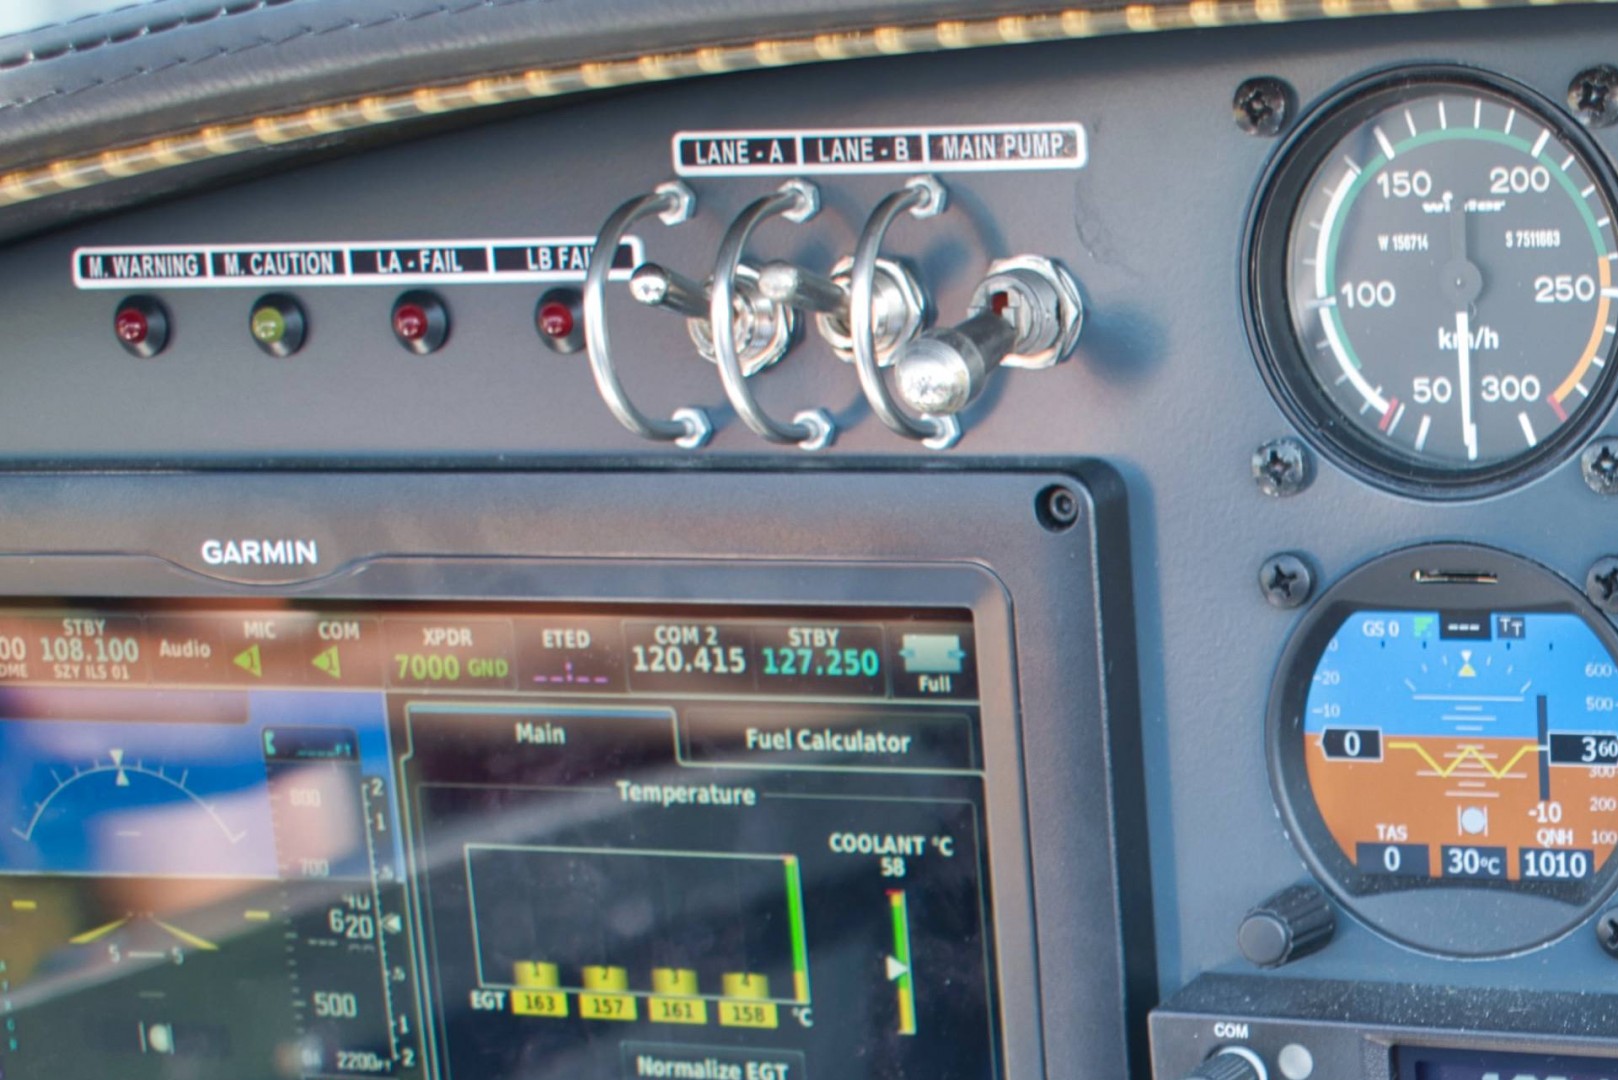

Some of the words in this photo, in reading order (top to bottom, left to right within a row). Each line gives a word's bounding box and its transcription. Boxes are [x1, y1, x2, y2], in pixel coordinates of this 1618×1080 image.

[695, 140, 749, 164] LANE
[769, 140, 784, 163] A
[818, 139, 873, 162] LANE
[895, 138, 909, 161] B
[942, 135, 996, 159] MAIN
[1004, 133, 1063, 158] PUMP
[1377, 170, 1431, 198] 150
[1490, 166, 1550, 192] 200
[89, 256, 108, 277] M.
[113, 255, 198, 277] WARNING
[225, 254, 245, 276] M.
[251, 252, 334, 275] CAUTION
[376, 251, 401, 272] LA
[420, 250, 462, 272] FAIL
[527, 248, 550, 270] LB
[560, 247, 594, 270] FAI
[1341, 281, 1395, 308] 100
[1534, 275, 1595, 302] 250
[1413, 377, 1452, 403] 50
[1481, 376, 1540, 401] 300
[201, 539, 317, 564] GARMIN
[63, 619, 106, 636] STBY
[244, 622, 276, 638] MIC
[318, 622, 360, 639] COM
[423, 628, 473, 646] XPDR
[788, 627, 839, 648] STBY
[40, 638, 138, 662] 108.100
[159, 640, 211, 658] Audio
[632, 645, 746, 674] 120.415
[53, 664, 81, 678] SZY
[85, 664, 108, 679] ILS
[112, 665, 129, 679] 01
[395, 654, 459, 679] 7000
[468, 659, 508, 679] GND
[763, 648, 879, 676] 127.250
[919, 674, 950, 692] Full
[516, 723, 565, 744] Main
[746, 728, 792, 751] Fuel
[797, 729, 911, 755] Calculator
[616, 781, 756, 806] Temperature
[1376, 824, 1407, 841] TAS
[1537, 829, 1573, 845] QNH
[1524, 851, 1587, 878] 1010
[314, 991, 356, 1017] 500
[1214, 1023, 1249, 1040] COM
